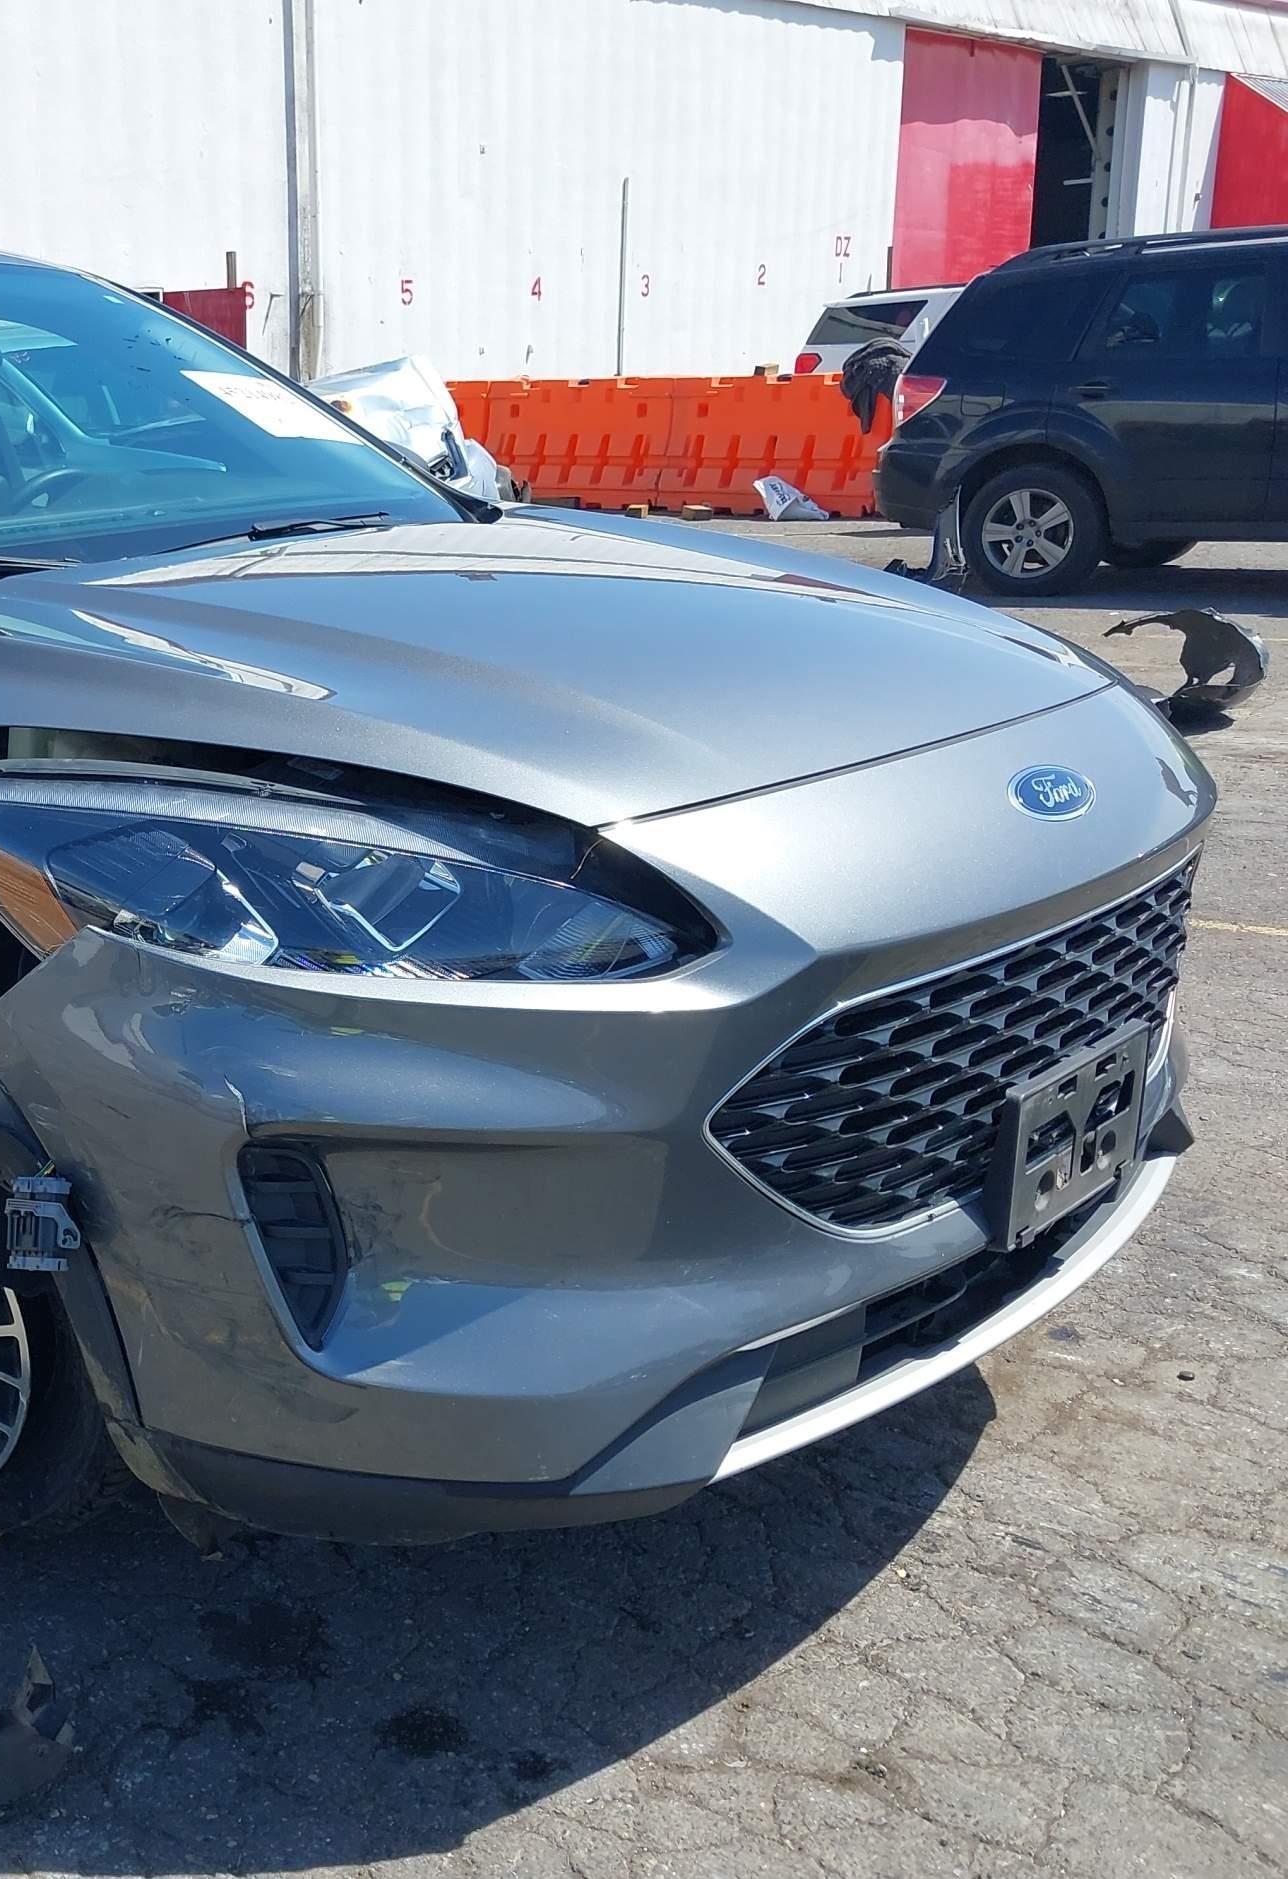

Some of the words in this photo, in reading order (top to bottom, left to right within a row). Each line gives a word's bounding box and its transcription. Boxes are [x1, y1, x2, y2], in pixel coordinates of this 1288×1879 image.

[640, 274, 651, 297] 3
[757, 263, 767, 286] 2
[400, 279, 414, 306] 5
[530, 276, 542, 301] 4
[1031, 773, 1082, 808] Ford
